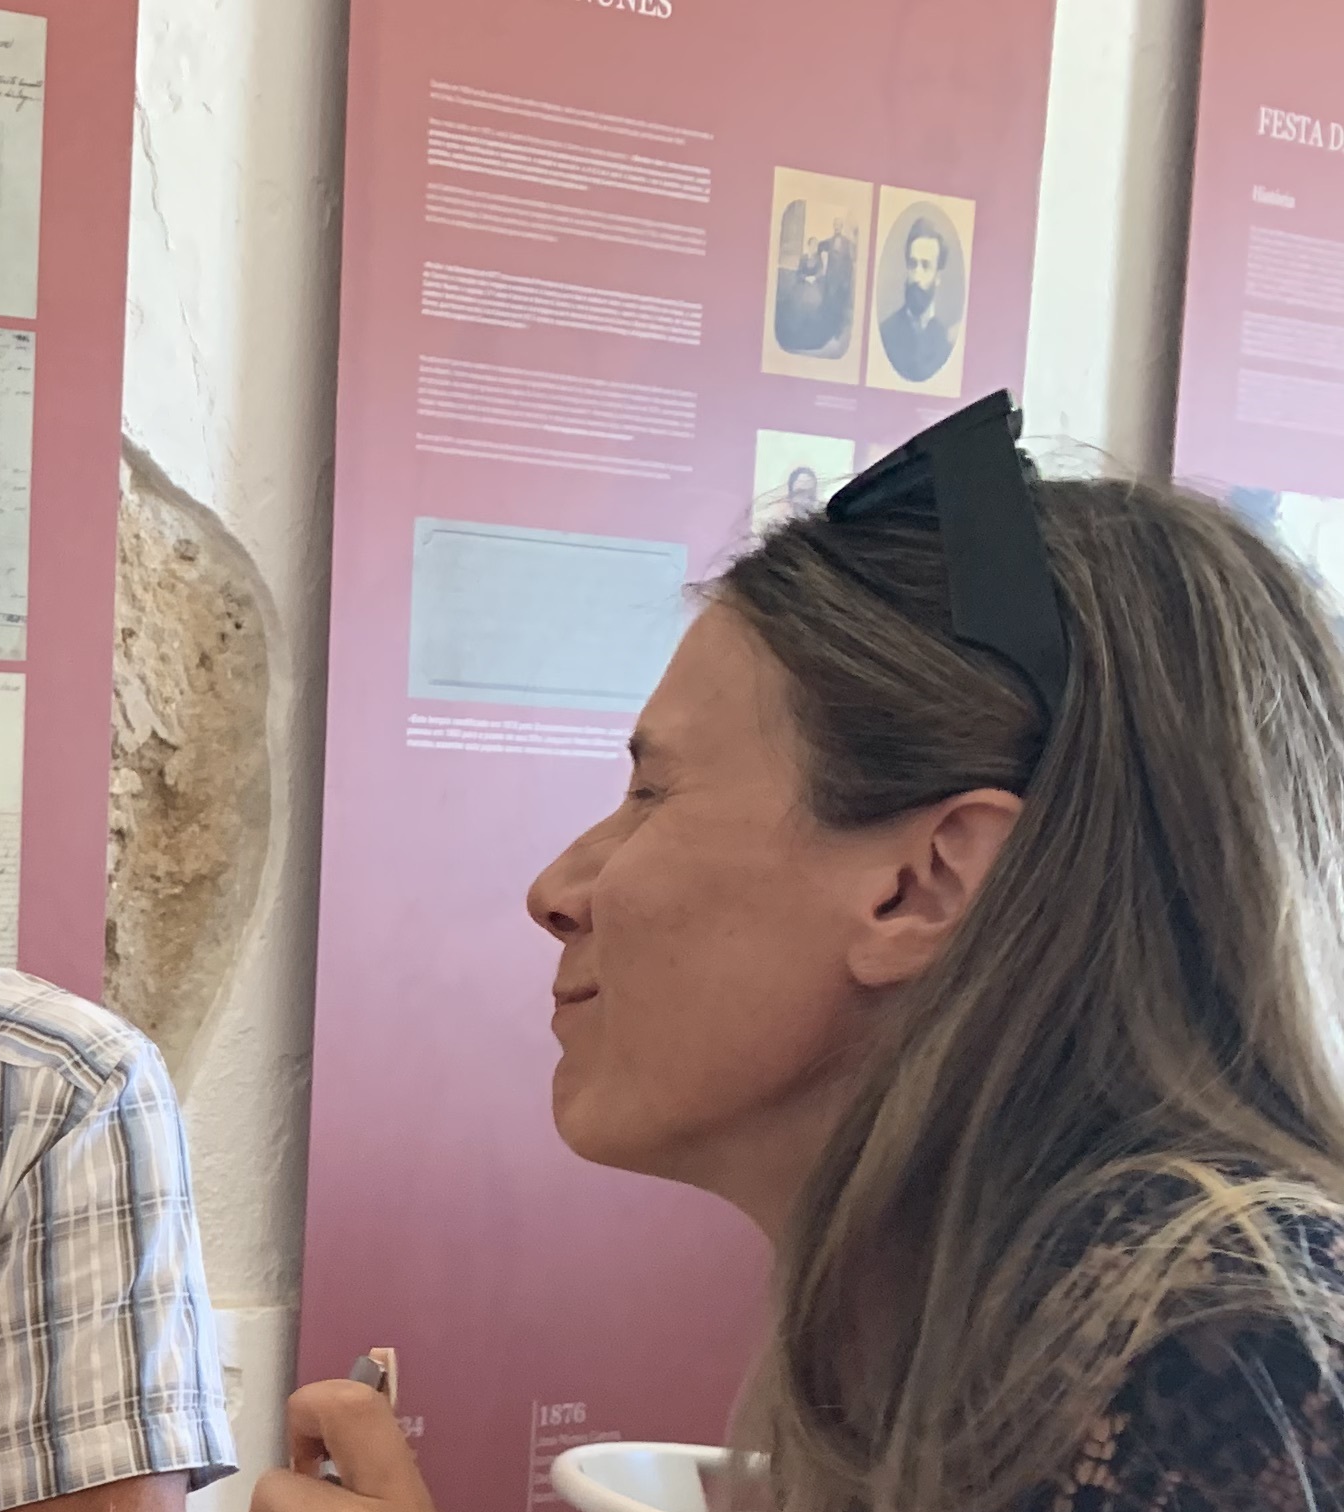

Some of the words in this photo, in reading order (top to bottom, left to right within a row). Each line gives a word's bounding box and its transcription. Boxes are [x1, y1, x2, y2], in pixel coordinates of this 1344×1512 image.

[1257, 106, 1323, 147] FESTA
[1329, 122, 1344, 154] D
[540, 1402, 596, 1426] 1876
